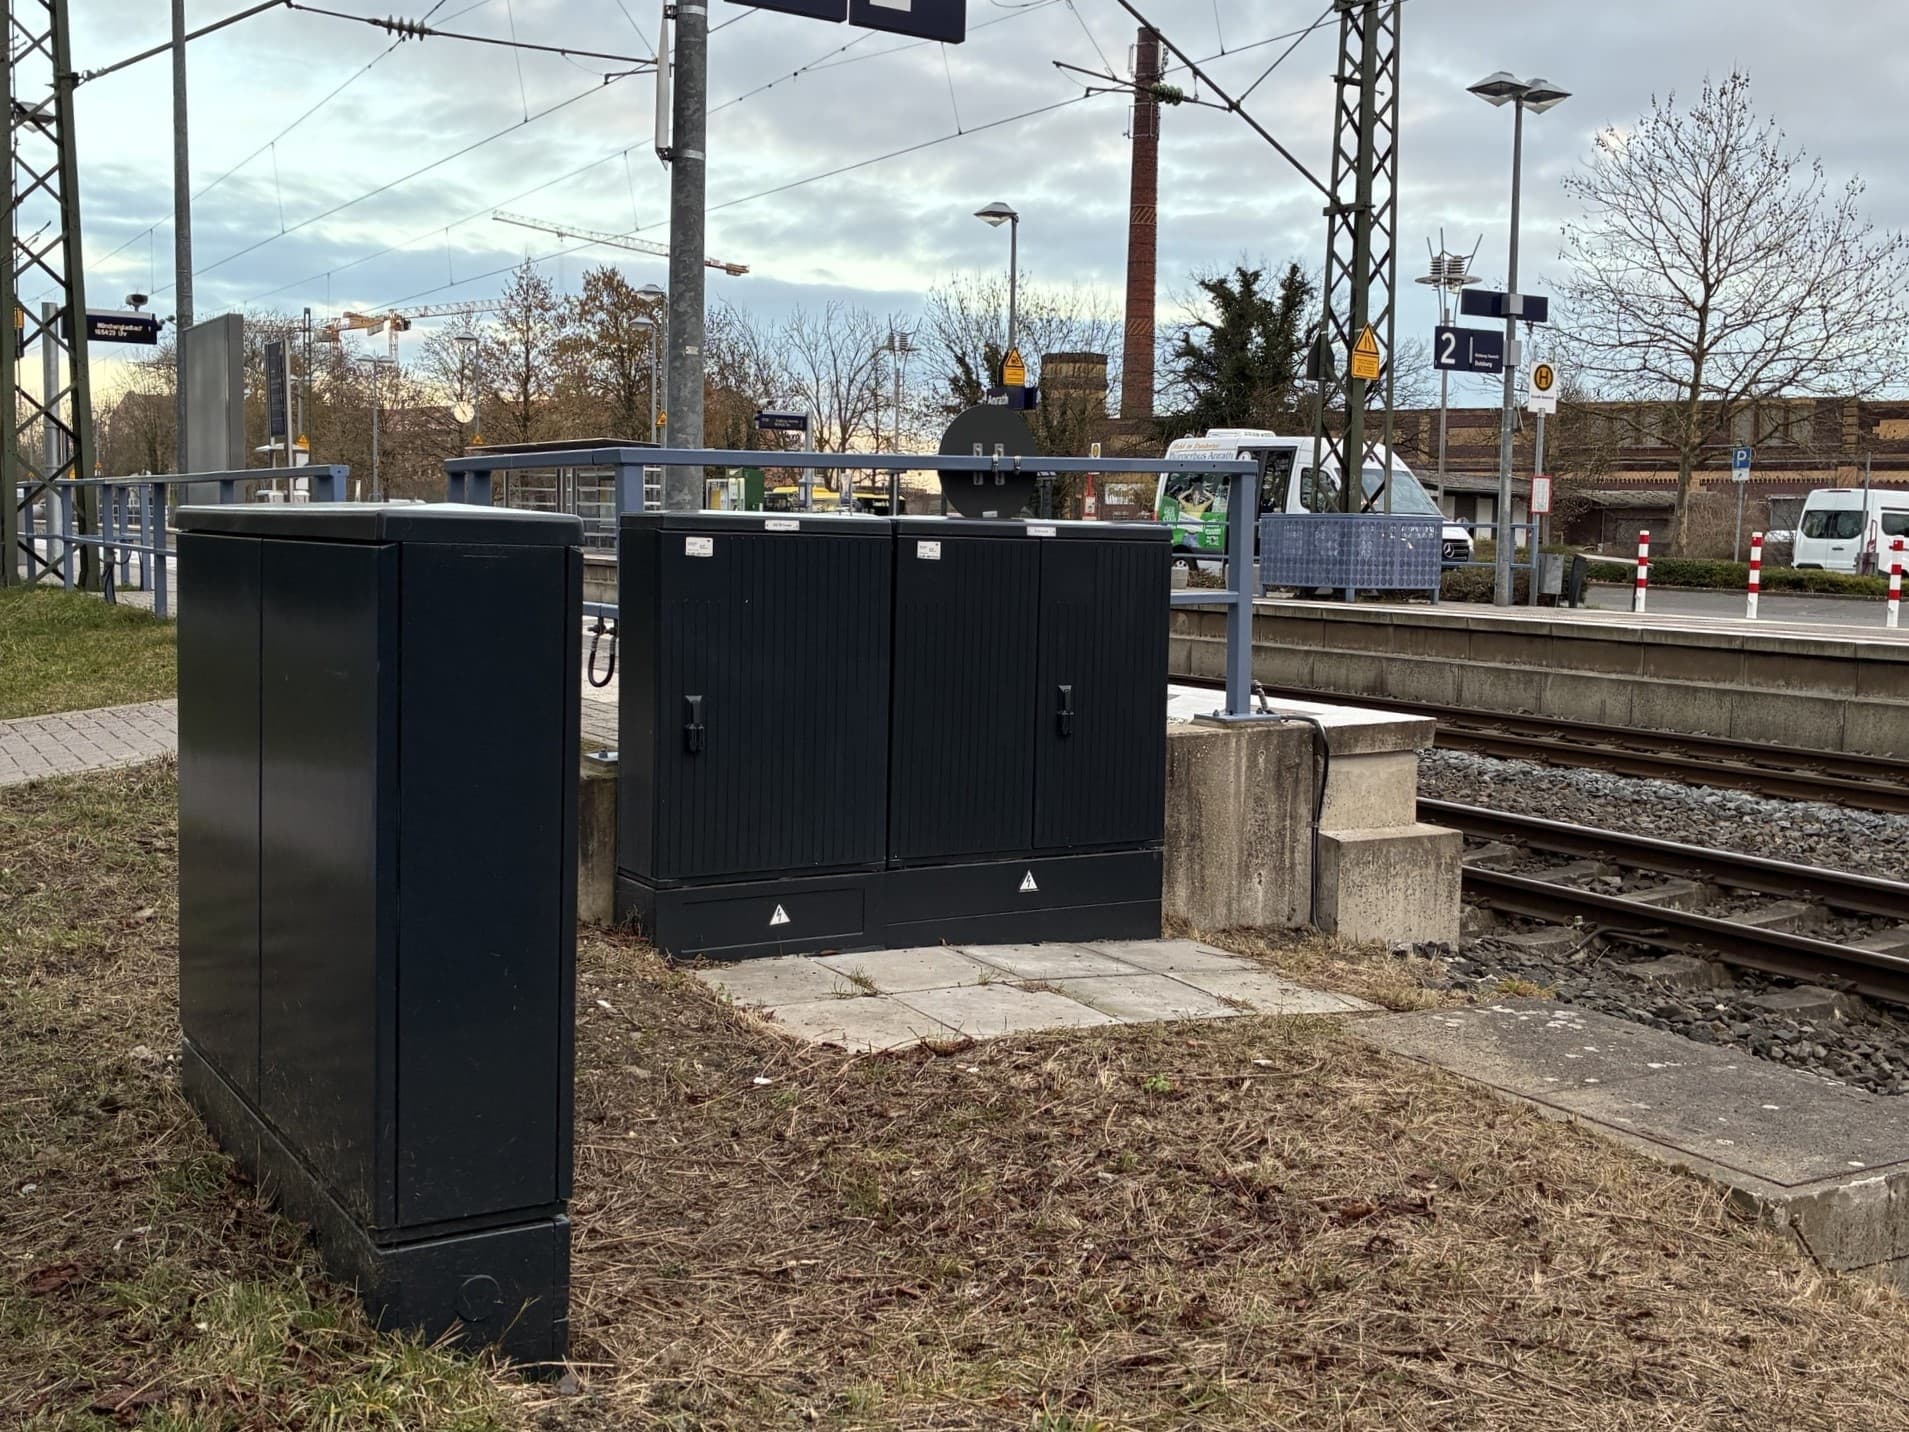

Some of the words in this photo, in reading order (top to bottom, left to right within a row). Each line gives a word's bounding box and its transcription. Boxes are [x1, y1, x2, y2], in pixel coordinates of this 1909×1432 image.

[1441, 332, 1456, 365] 2
[1539, 370, 1549, 385] H
[1736, 450, 1747, 467] P
